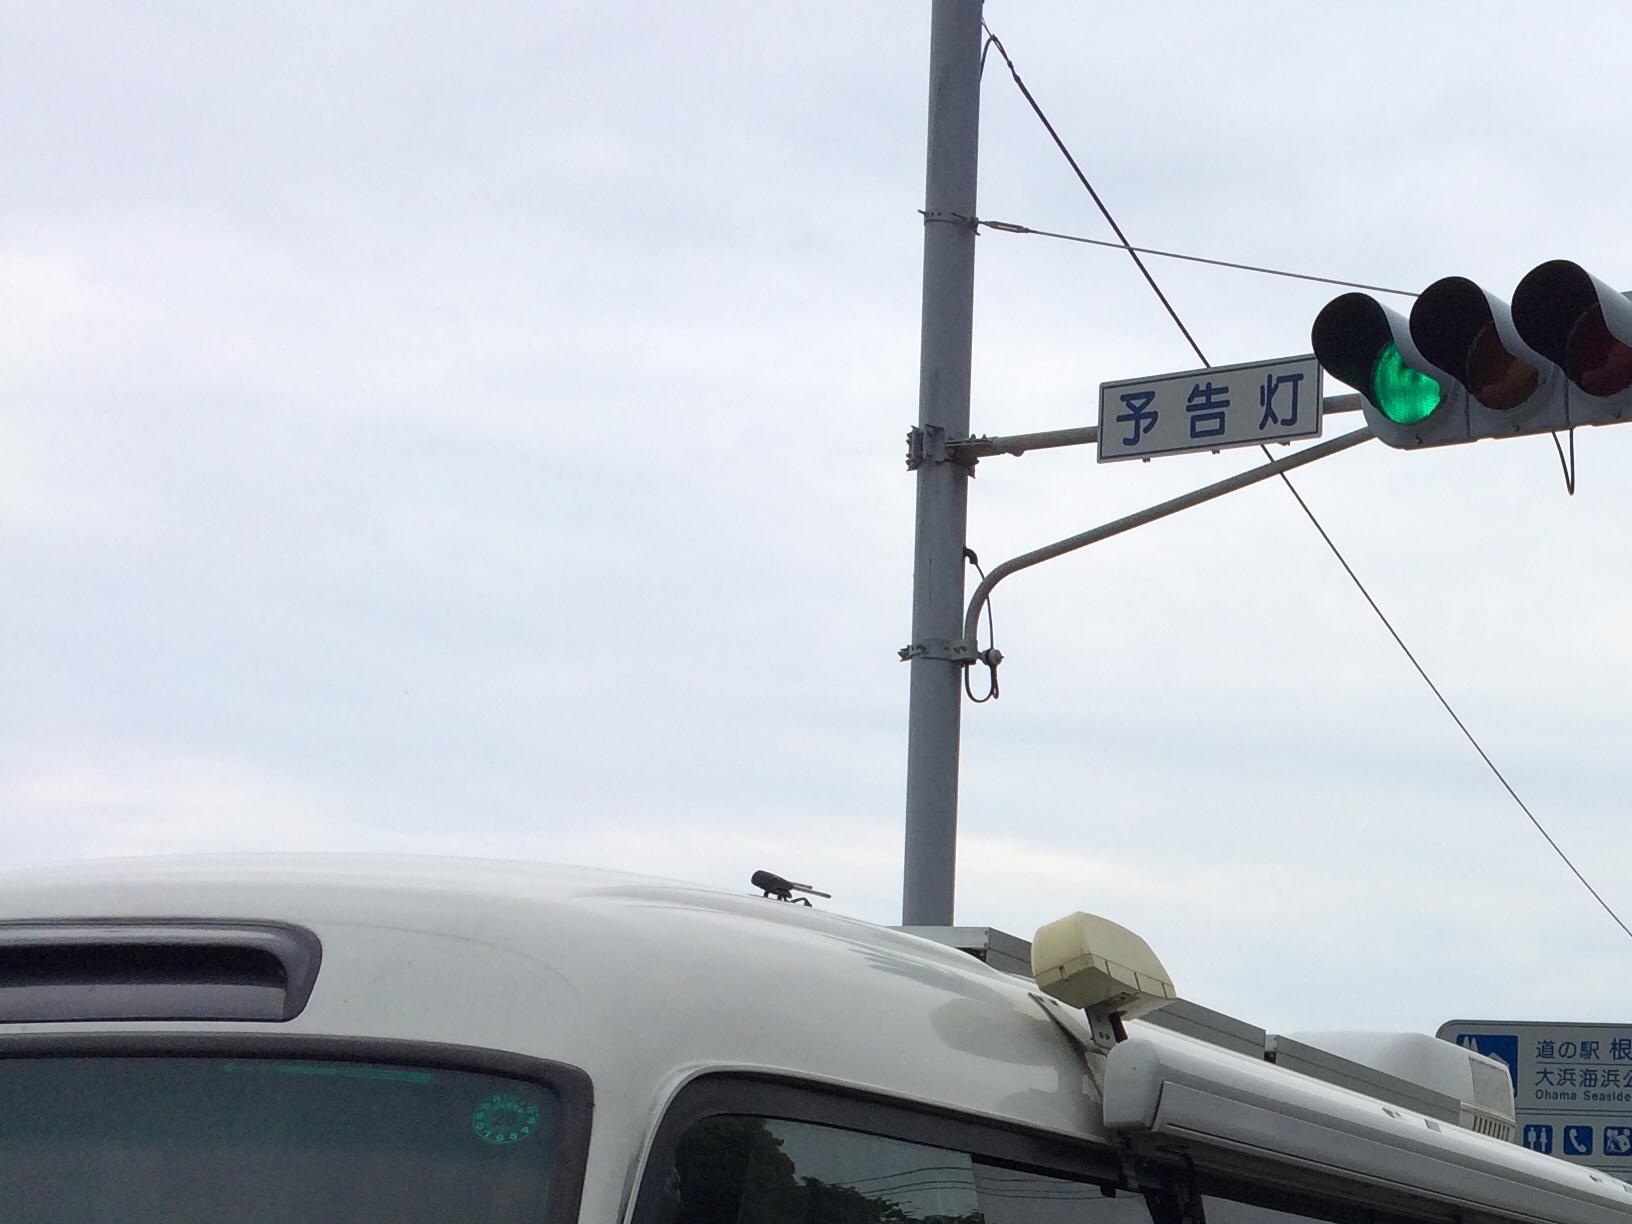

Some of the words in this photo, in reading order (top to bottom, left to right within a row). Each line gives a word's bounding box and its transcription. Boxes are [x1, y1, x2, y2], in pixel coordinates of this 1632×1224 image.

[1116, 373, 1304, 446] 予告灯
[1535, 1089, 1577, 1101] Ohama
[1583, 1090, 1632, 1102] Seaside
